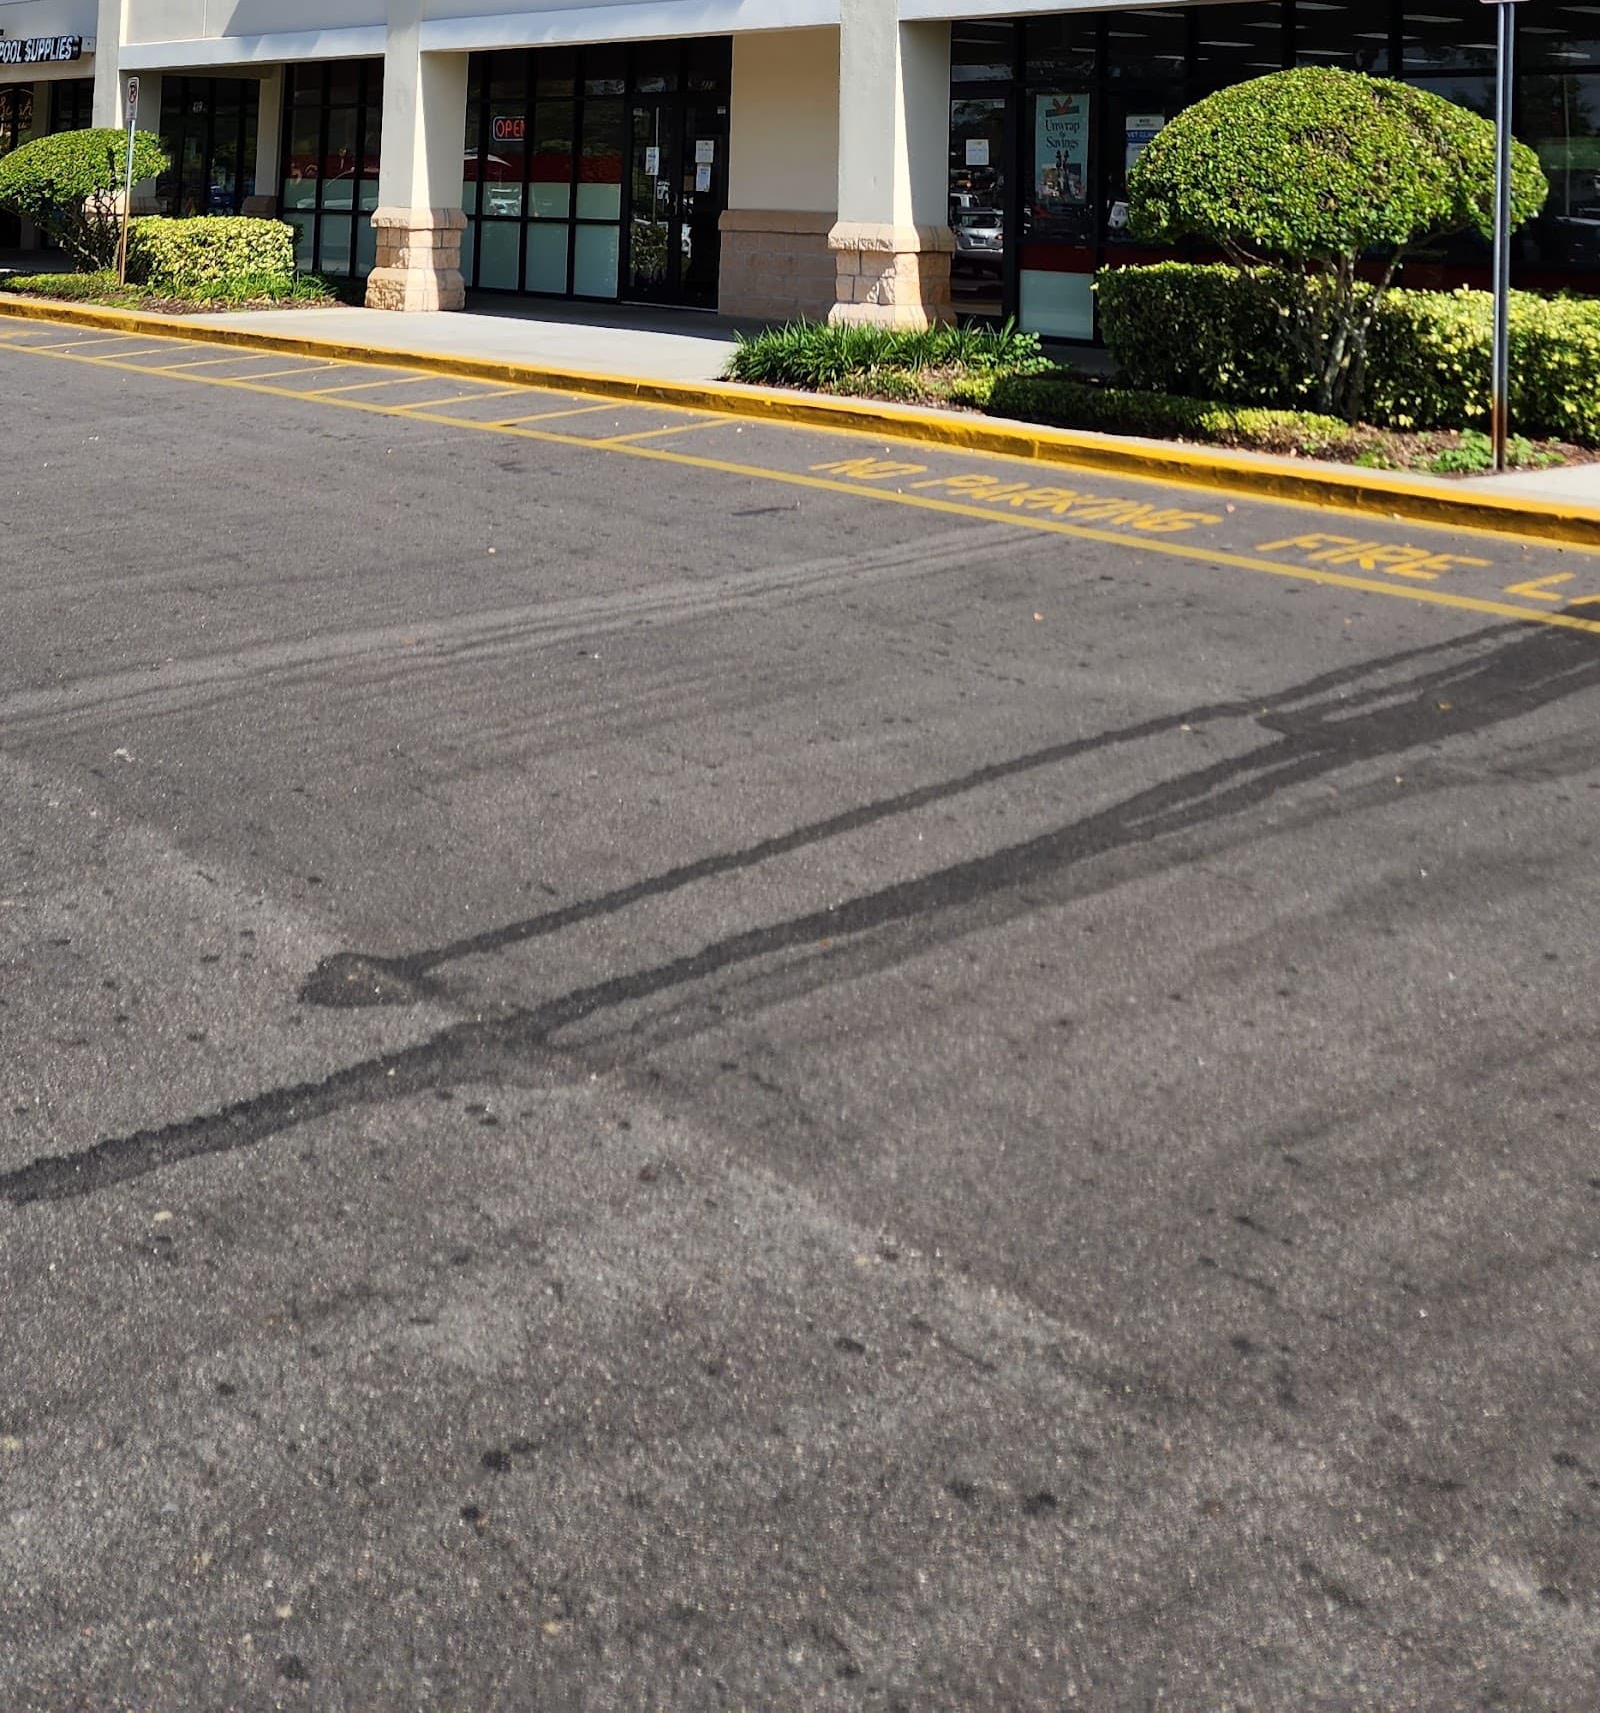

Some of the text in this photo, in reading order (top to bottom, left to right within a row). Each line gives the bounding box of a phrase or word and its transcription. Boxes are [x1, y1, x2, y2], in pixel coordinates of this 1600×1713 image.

[24, 35, 74, 63] SUPPLIES
[810, 456, 1600, 606] NO PARKING FIRE L
